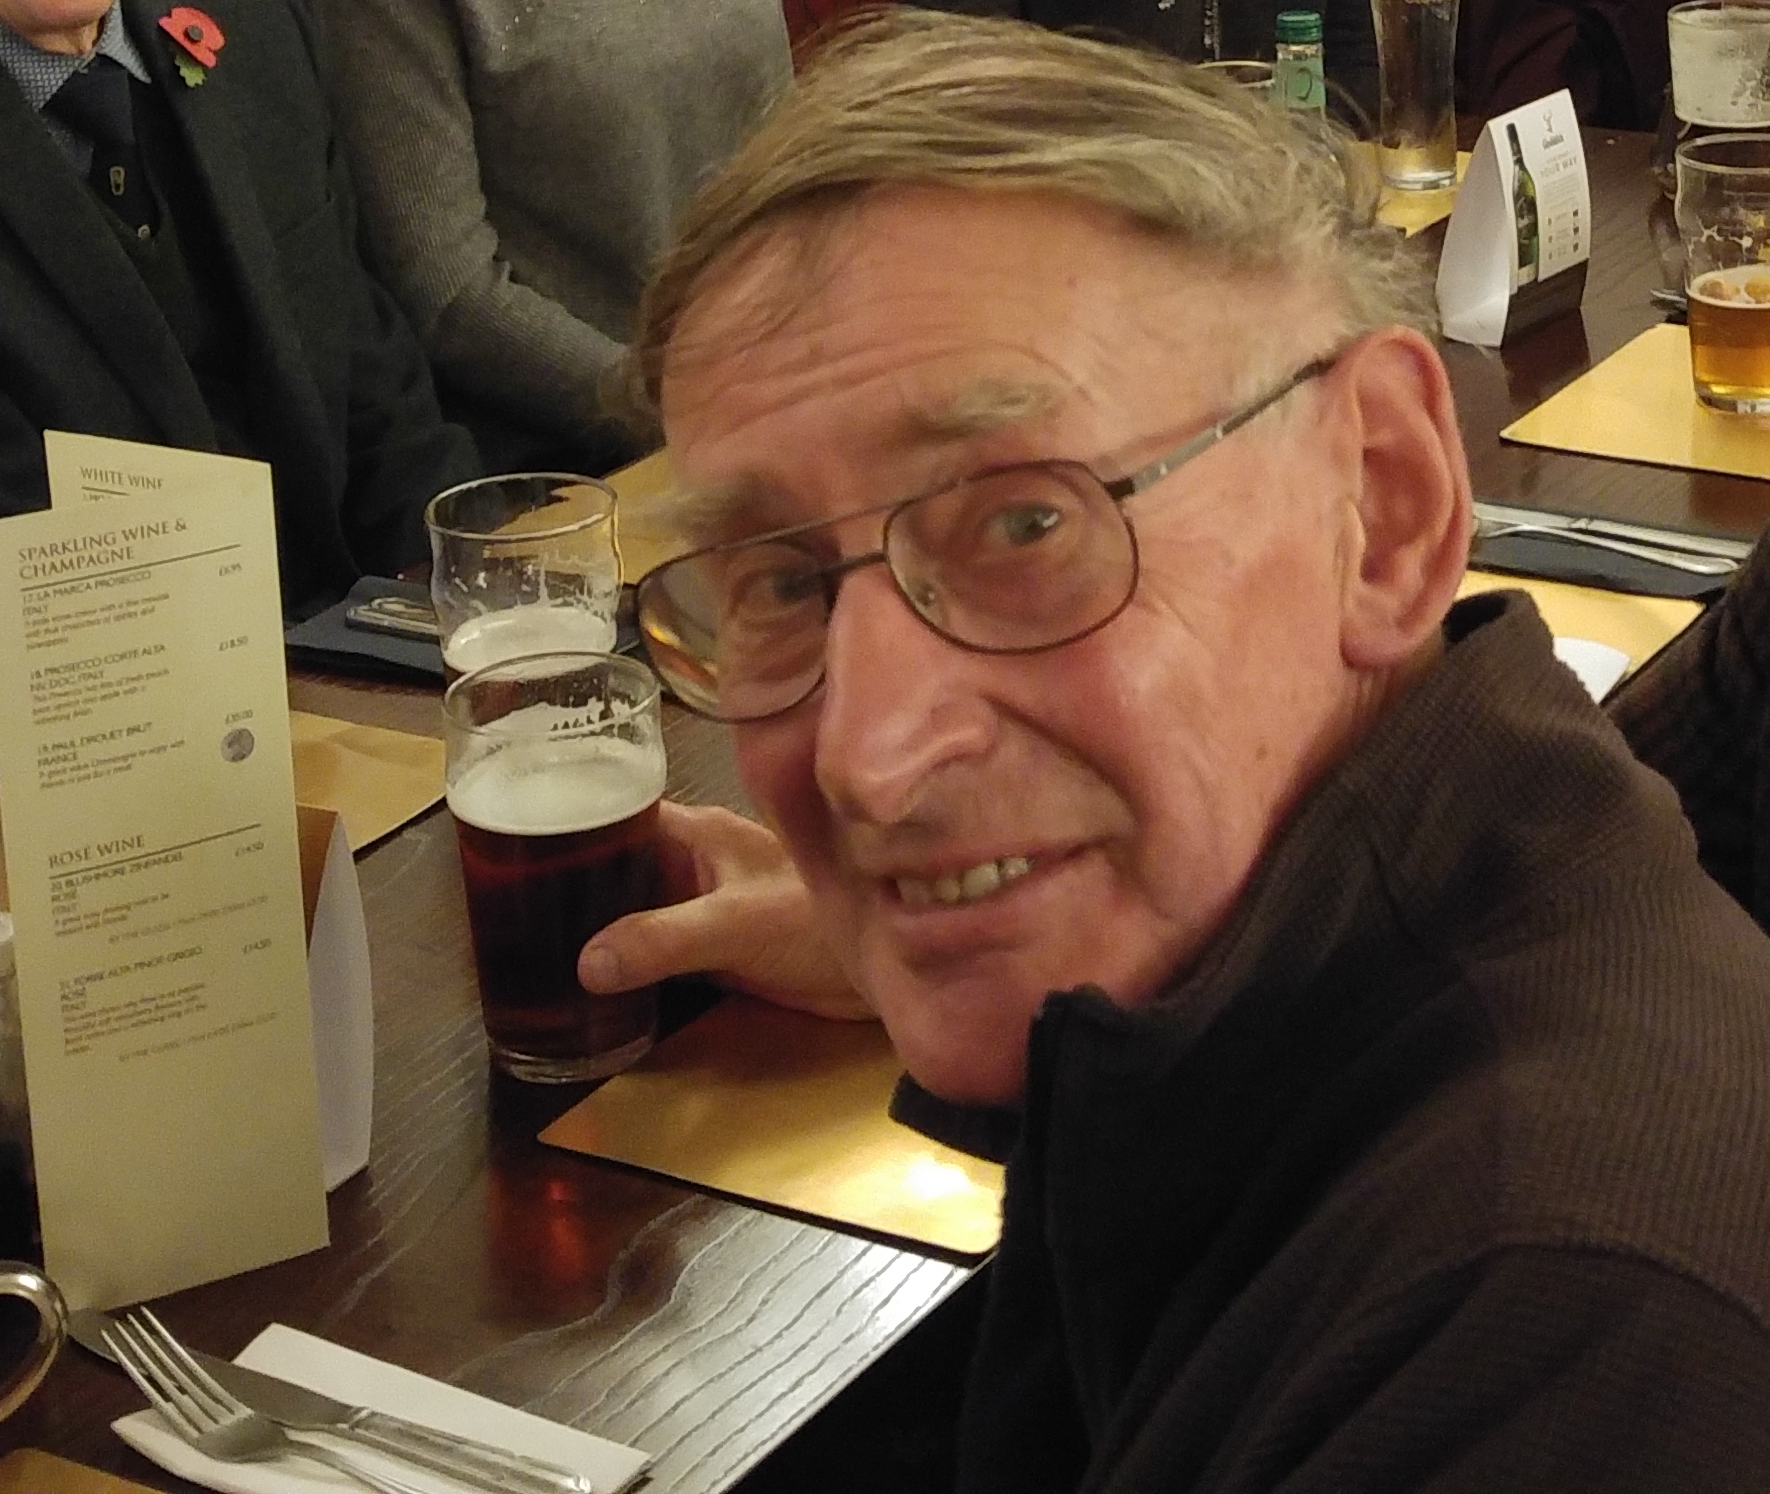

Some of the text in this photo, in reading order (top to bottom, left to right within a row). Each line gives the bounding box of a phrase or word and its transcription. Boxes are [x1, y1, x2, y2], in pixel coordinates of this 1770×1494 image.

[80, 466, 124, 486] WHITE
[18, 518, 187, 564] SPARKLING WINE &
[19, 546, 135, 580] CHAMPAGNE
[95, 569, 151, 590] PROSECCO
[44, 656, 101, 677] PROSECCO
[97, 833, 144, 857] WINE
